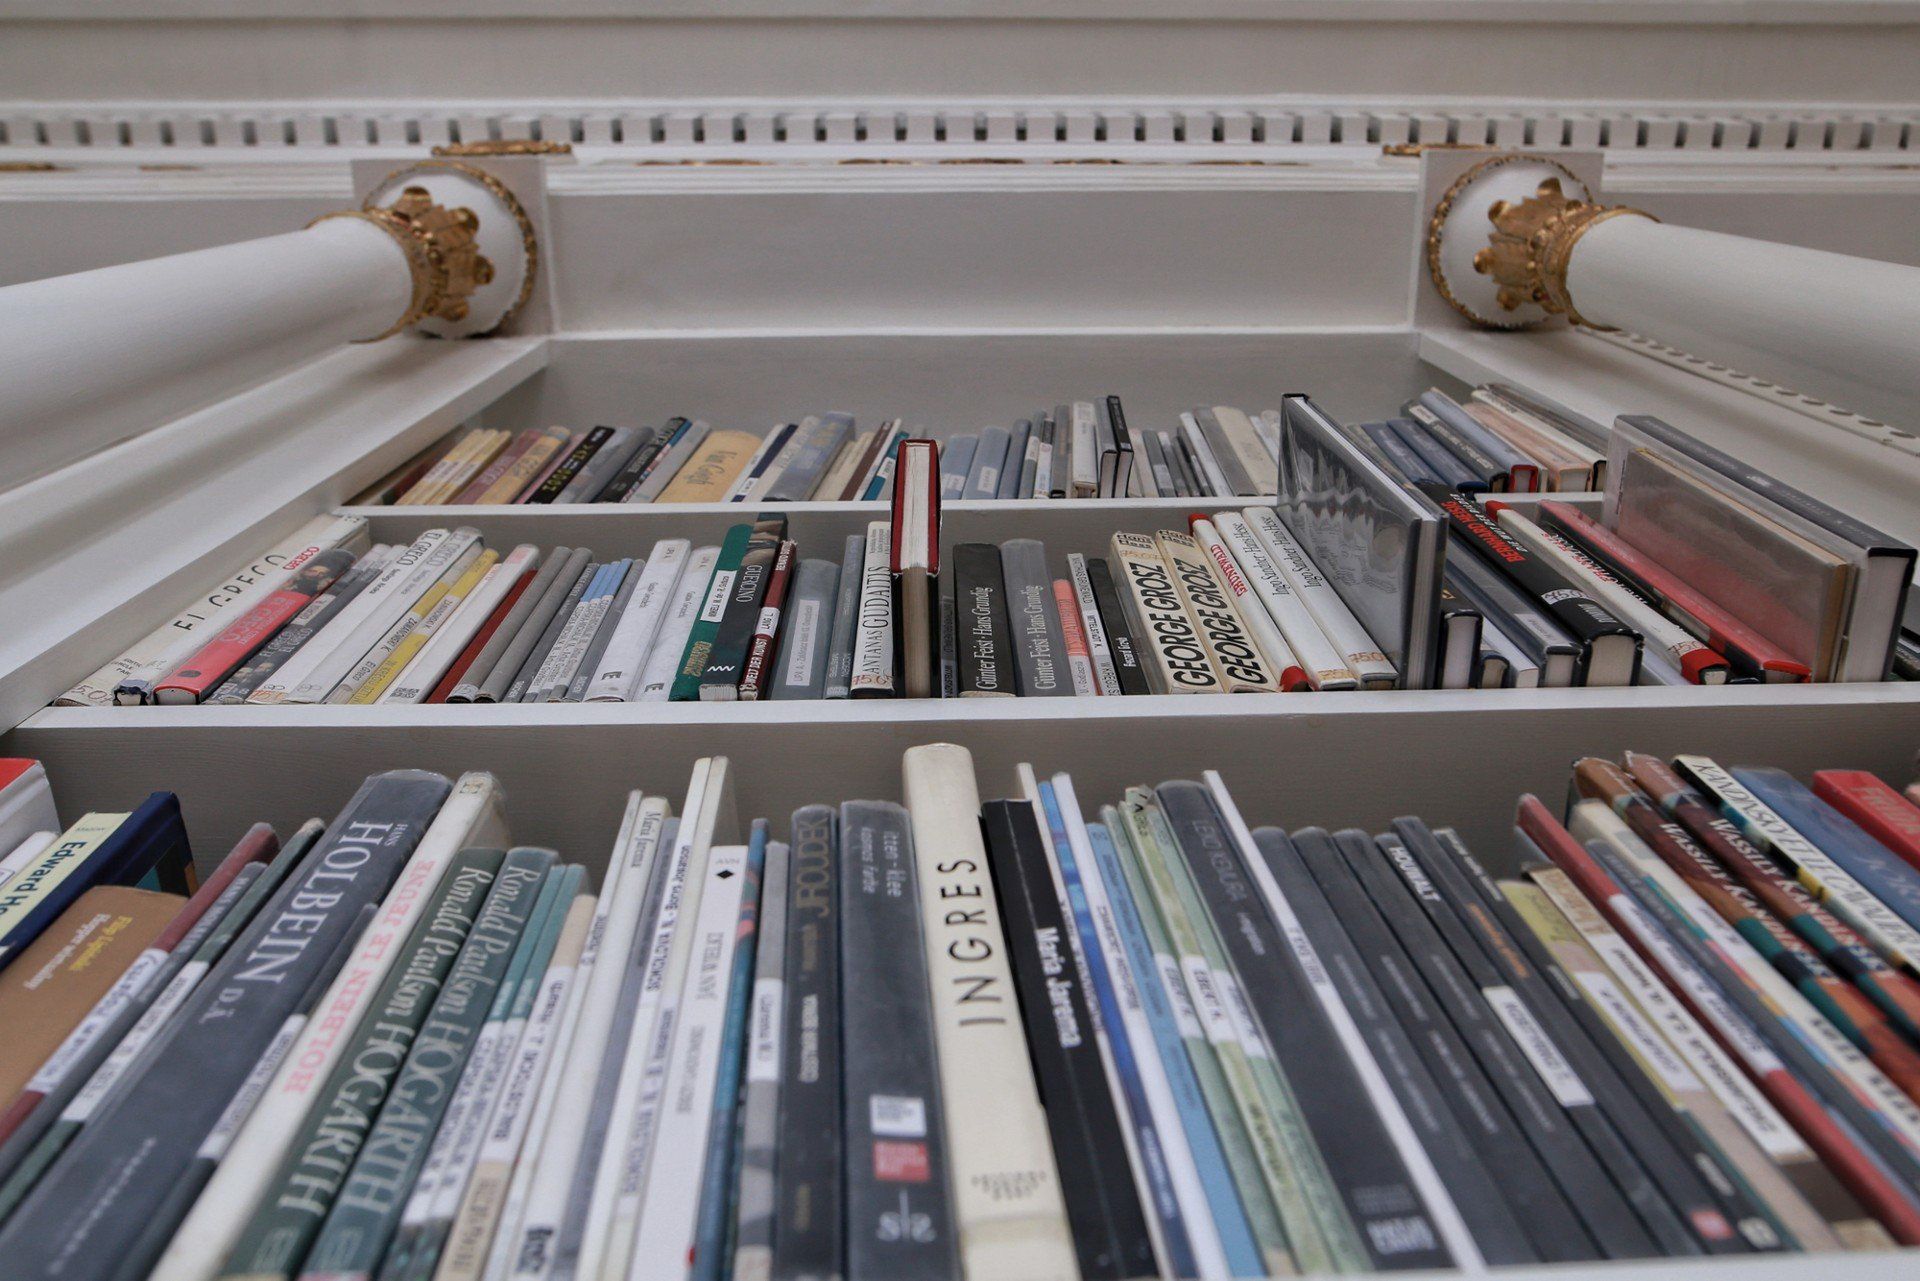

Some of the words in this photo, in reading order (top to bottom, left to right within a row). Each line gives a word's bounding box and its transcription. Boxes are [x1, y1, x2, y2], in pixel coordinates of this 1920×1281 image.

[1232, 522, 1252, 538] Hesse
[1260, 516, 1281, 532] Hesse
[1475, 513, 1496, 527] DER
[1489, 526, 1512, 540] WUT
[424, 532, 443, 541] EL
[1243, 537, 1262, 553] Hans
[1272, 531, 1293, 547] Hans
[1467, 523, 1525, 563] BERNHARD
[1507, 540, 1528, 552] DIE
[283, 546, 320, 570] GRECO
[397, 541, 432, 566] GRECO
[426, 542, 460, 566] GRECO
[1254, 551, 1284, 582] Sandner
[1284, 545, 1313, 573] Sandner
[735, 564, 763, 603] GUERCINO
[1129, 562, 1183, 612] GROSZ
[1172, 557, 1228, 608] GROSZ
[1268, 579, 1290, 596] Ingo
[1301, 572, 1323, 589] Ingo
[862, 566, 891, 628] GUDAITIS
[970, 586, 994, 615] Grundig
[1021, 584, 1044, 614] Grundig
[762, 616, 772, 630] LANG
[972, 615, 993, 636] Hans
[1026, 615, 1047, 635] Hans
[753, 637, 767, 655] KUNST
[863, 630, 883, 676] ANTANAS
[973, 637, 995, 659] Feist
[1029, 638, 1051, 659] Feist
[1149, 610, 1217, 687] GEORGE
[1203, 607, 1269, 684] GEORGE
[750, 654, 762, 669] DER
[976, 659, 998, 690] Günter
[1034, 658, 1057, 690] Günter
[1692, 763, 1797, 842] KANDINSKY
[384, 822, 409, 846] HANS
[636, 809, 663, 840] Maria
[13, 841, 88, 893] Edward
[245, 819, 393, 986] HOLBEIN
[431, 865, 495, 945] Ronald
[480, 865, 542, 943] Ronald
[1660, 823, 1728, 879] WASSILY
[1723, 884, 1840, 983] KANDINSKY
[1709, 819, 1783, 876] WASSILY
[1774, 879, 1897, 977] KANDINSKY
[937, 859, 1007, 1027] INGRES
[1036, 926, 1064, 976] Maria
[283, 967, 374, 1094] HOLBEIN
[361, 931, 396, 963] LE
[383, 858, 437, 930] JEUNE
[385, 936, 461, 1017] Paulson
[438, 936, 510, 1016] Paulson
[1046, 978, 1082, 1049] Jarema
[278, 1021, 415, 1217] HOGARTH
[345, 1019, 471, 1216] HOGARTH
